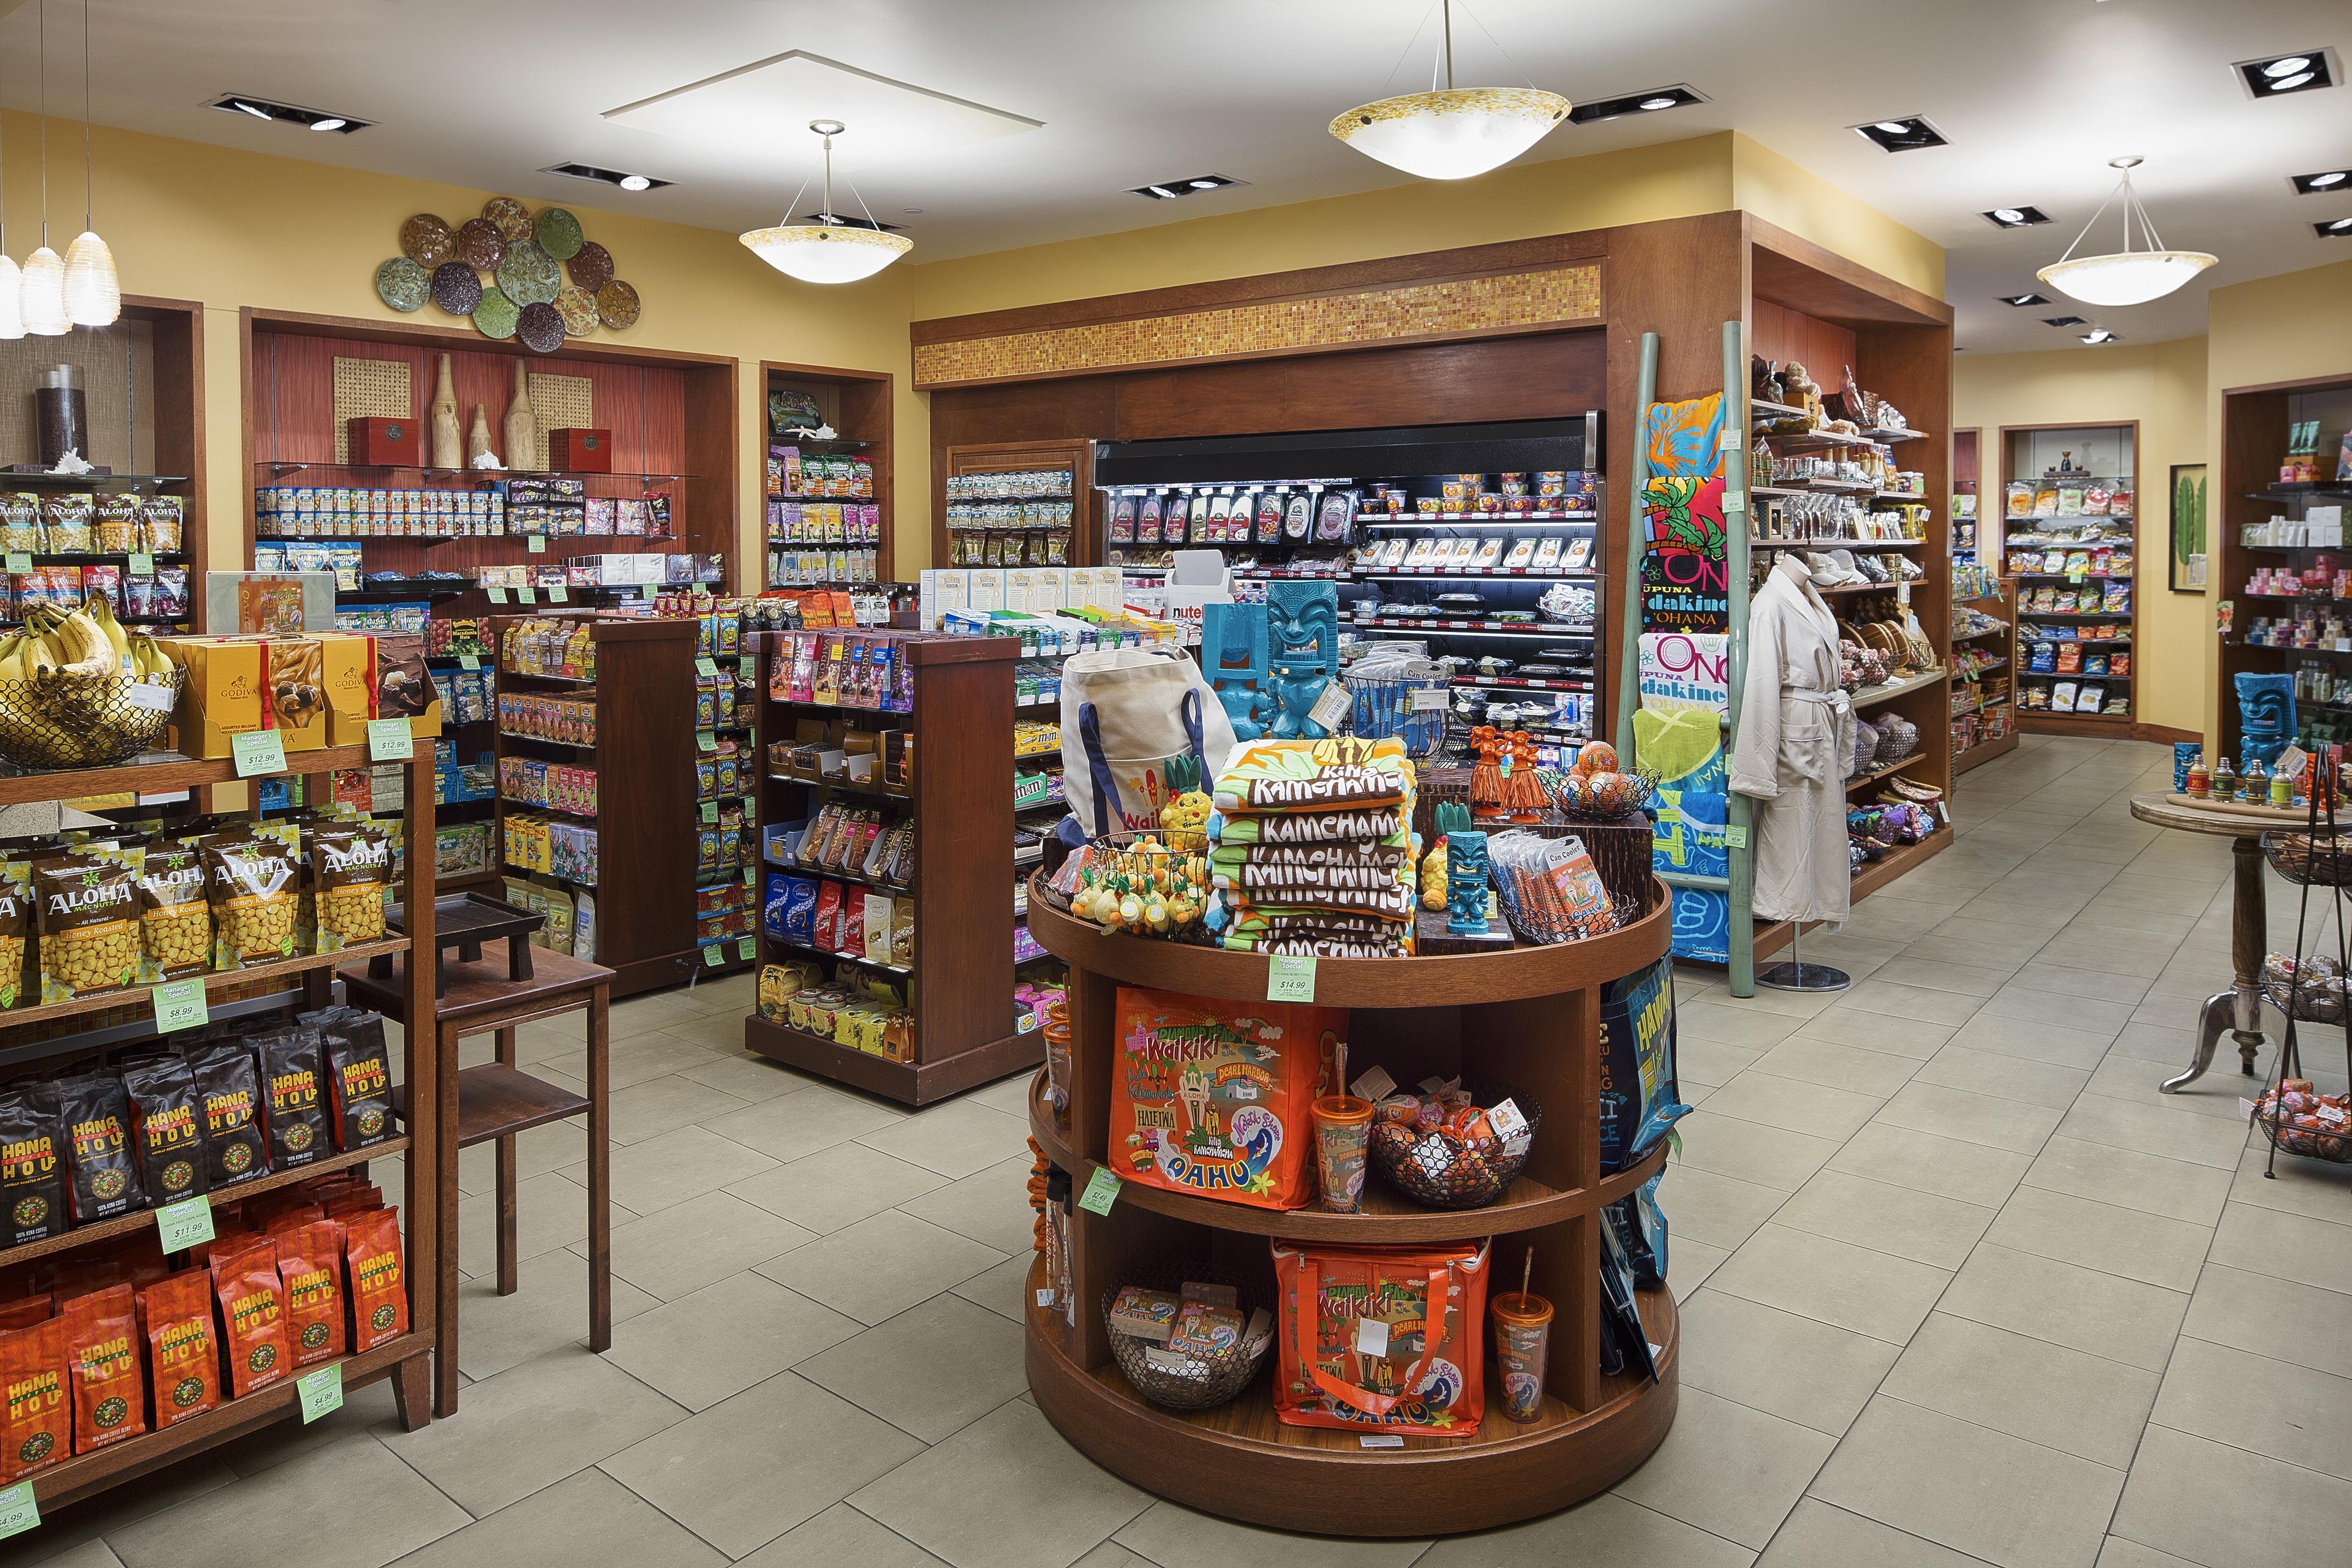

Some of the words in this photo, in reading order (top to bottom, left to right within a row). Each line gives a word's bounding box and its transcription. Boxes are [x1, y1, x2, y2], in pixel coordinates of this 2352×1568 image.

[50, 508, 88, 517] ALOHA
[98, 508, 133, 517] ALOHA
[143, 508, 179, 517] ALOHA
[818, 638, 829, 679] GODIVA
[841, 640, 851, 680] GODIVA
[861, 641, 871, 682] GODIVA
[892, 643, 903, 685] GODIVA
[221, 689, 257, 698] GODIVA
[1641, 679, 1726, 703] dakine
[241, 733, 271, 741] Manager's
[249, 754, 275, 764] $12.99
[1562, 845, 1580, 858] Cooler
[323, 849, 388, 873] ALOHA
[216, 858, 286, 886] ALOHA
[48, 883, 132, 915] ALOHA
[74, 903, 92, 912] MAC
[230, 899, 253, 908] Honey
[255, 894, 282, 903] Roasted
[153, 909, 177, 918] Honey
[179, 903, 204, 914] Roasted
[66, 930, 92, 940] Honey
[94, 923, 123, 935] Roasted
[163, 984, 195, 993] Manager's
[168, 990, 191, 998] Special
[170, 1007, 192, 1017] $8.99
[1158, 1027, 1206, 1041] DIAMOND
[1208, 1025, 1235, 1041] HEAD
[1147, 1035, 1220, 1063] Waikiki
[343, 1058, 380, 1079] HANA
[1125, 1069, 1147, 1082] Duke
[1242, 1065, 1270, 1083] HARBOR
[273, 1071, 313, 1090] HANA
[347, 1075, 385, 1096] HOU
[274, 1088, 317, 1108] HOU
[147, 1106, 190, 1128] HANA
[149, 1123, 196, 1147] HOU
[1233, 1110, 1261, 1144] North
[1262, 1112, 1281, 1142] Shore
[2, 1137, 51, 1159] HANA
[1208, 1136, 1221, 1147] King
[3, 1156, 56, 1179] HOU
[1167, 1156, 1251, 1189] OAHU
[1092, 1192, 1107, 1201] $2.49
[167, 1201, 198, 1213] Manager's
[173, 1207, 195, 1218] Special
[175, 1223, 202, 1237] $11.99
[358, 1251, 396, 1274] HANA
[362, 1264, 394, 1278] COFFEE
[361, 1268, 399, 1292] HOU
[232, 1289, 273, 1316] HANA
[235, 1306, 279, 1333] HOU
[1114, 1308, 1156, 1321] OAHU
[160, 1320, 203, 1347] HANA
[164, 1333, 203, 1351] COFFEE
[163, 1337, 209, 1365] HOU
[9, 1370, 57, 1400] HANA
[306, 1370, 333, 1384] Manager's
[311, 1376, 330, 1388] Special
[1441, 1363, 1459, 1389] Shore
[12, 1384, 56, 1404] COFFEE
[315, 1392, 333, 1406] $4.99
[10, 1390, 62, 1420] HOU
[97, 1402, 107, 1414] SEA
[111, 1398, 126, 1407] SALT
[98, 1412, 125, 1427] CARAMEL
[110, 1428, 121, 1437] COFFEE
